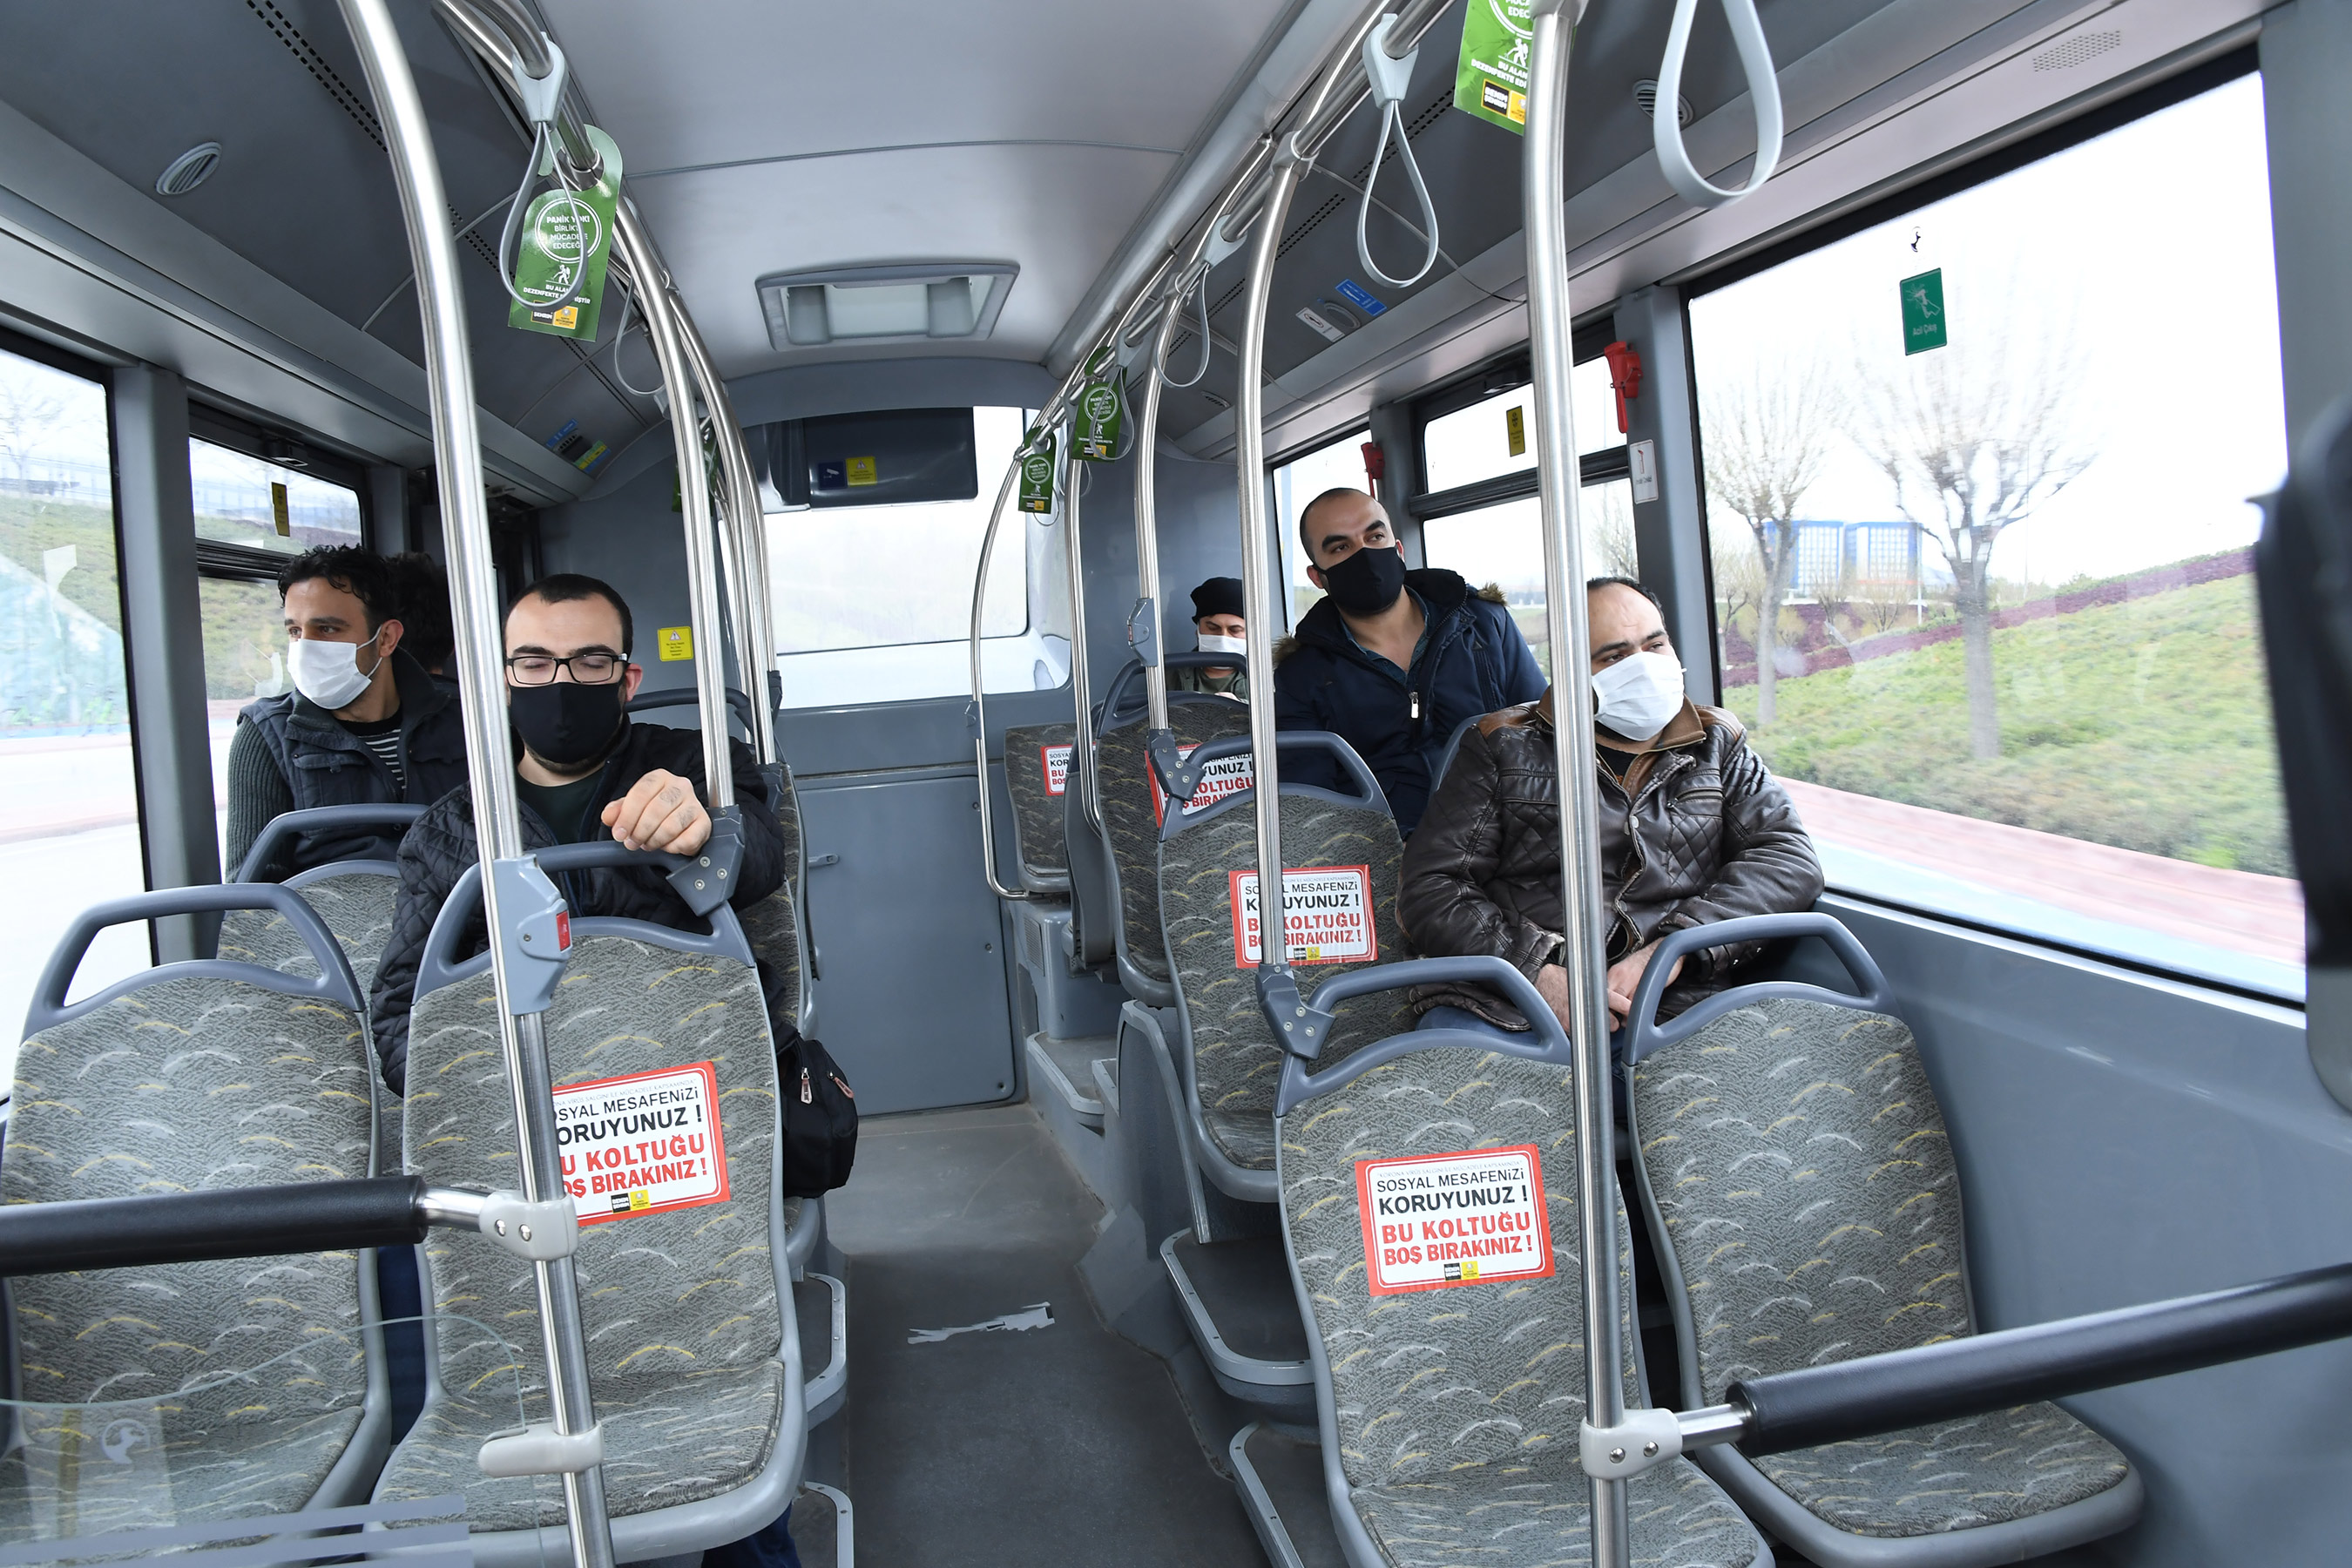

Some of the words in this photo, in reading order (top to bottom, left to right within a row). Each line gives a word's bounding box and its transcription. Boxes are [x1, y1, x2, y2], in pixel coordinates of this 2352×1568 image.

[1508, 6, 1531, 19] EDEC
[1497, 61, 1509, 71] BU
[546, 214, 570, 223] PANİK
[1194, 776, 1254, 794] OLTUĞU
[1246, 895, 1350, 911] KUYUNUZ
[1247, 917, 1259, 932] B
[554, 1104, 599, 1121] SYAL
[558, 1107, 688, 1146] ORUYUNUZ
[560, 1154, 576, 1176] U
[585, 1132, 705, 1172] KOLTUĞU
[591, 1159, 697, 1194] BIRAKINIZ
[1376, 1176, 1435, 1193] SOSYAL
[1379, 1186, 1515, 1216] KORUYUNUZ
[1382, 1223, 1413, 1244] BU
[1422, 1212, 1531, 1240] KOLTUĞU
[1383, 1246, 1423, 1266] BOŞ
[1427, 1236, 1523, 1261] BIRAKINIZ
